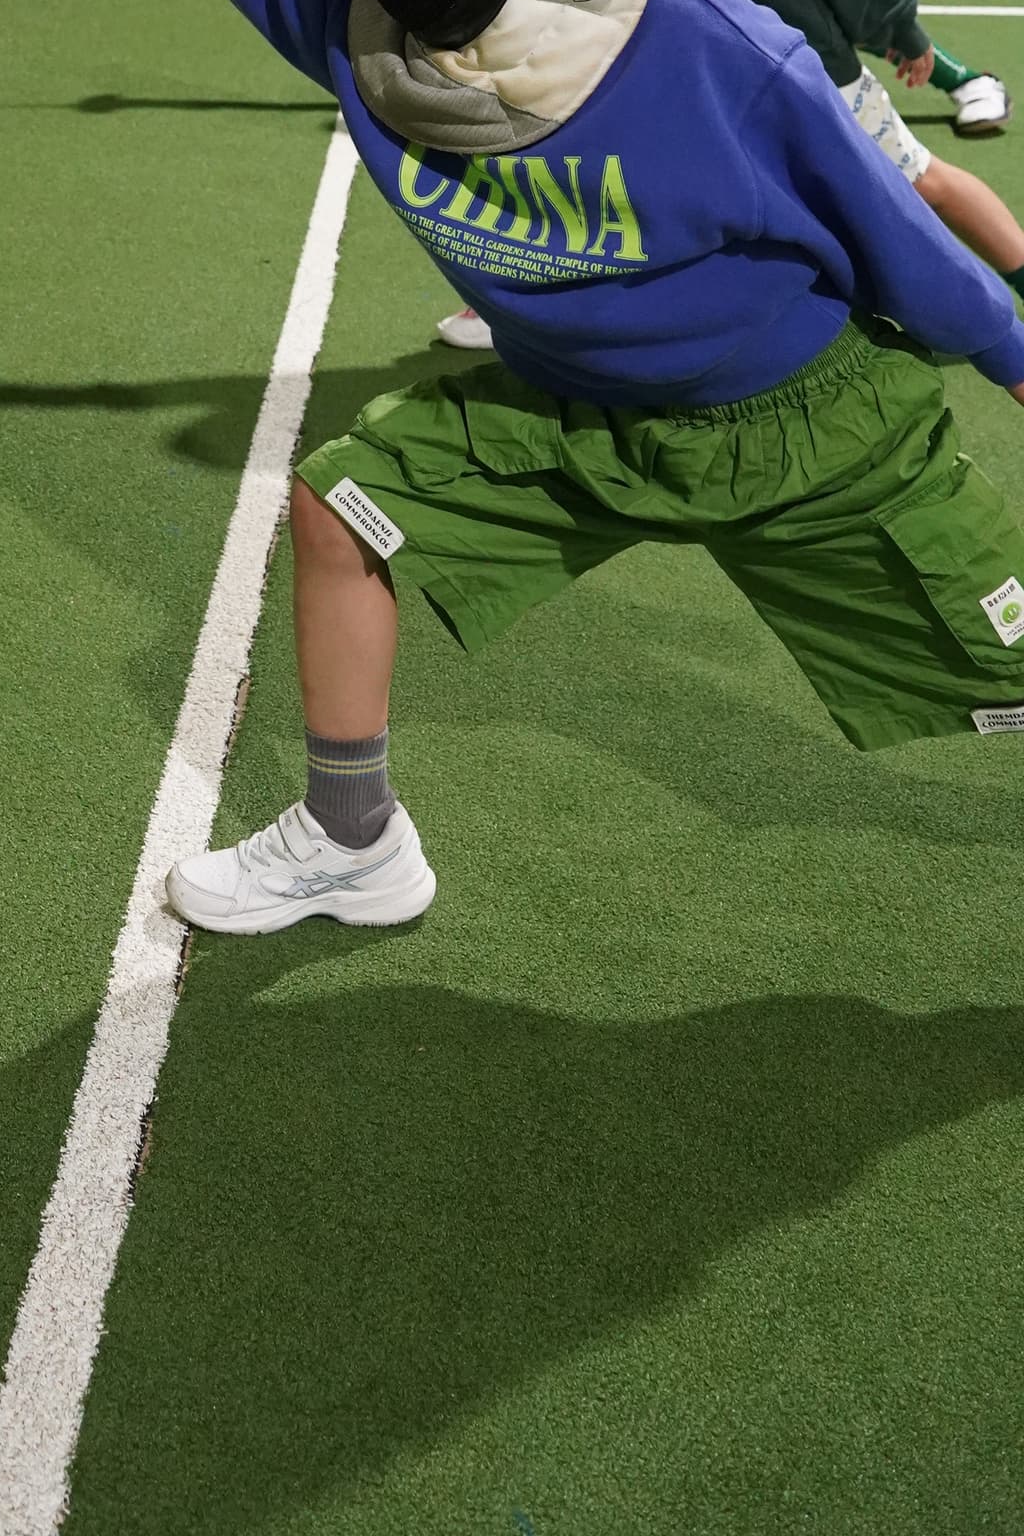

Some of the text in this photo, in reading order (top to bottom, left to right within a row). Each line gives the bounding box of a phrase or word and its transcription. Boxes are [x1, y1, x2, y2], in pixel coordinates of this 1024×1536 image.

[398, 143, 649, 262] CHINA
[418, 215, 436, 231] THE
[435, 222, 463, 240] GREAT
[463, 231, 485, 247] WALL
[485, 239, 525, 258] GARDENS
[525, 249, 553, 264] PANDA
[554, 255, 589, 272] TEMPLE
[589, 262, 604, 274] OF
[604, 266, 643, 276] HEAV
[437, 235, 451, 249] OF
[449, 239, 484, 258] HEAVEN
[484, 249, 502, 263] THE
[501, 254, 543, 274] IMPERIAL
[543, 265, 578, 280] PALACE
[456, 253, 478, 270] WALL
[478, 260, 518, 279] GARDENS
